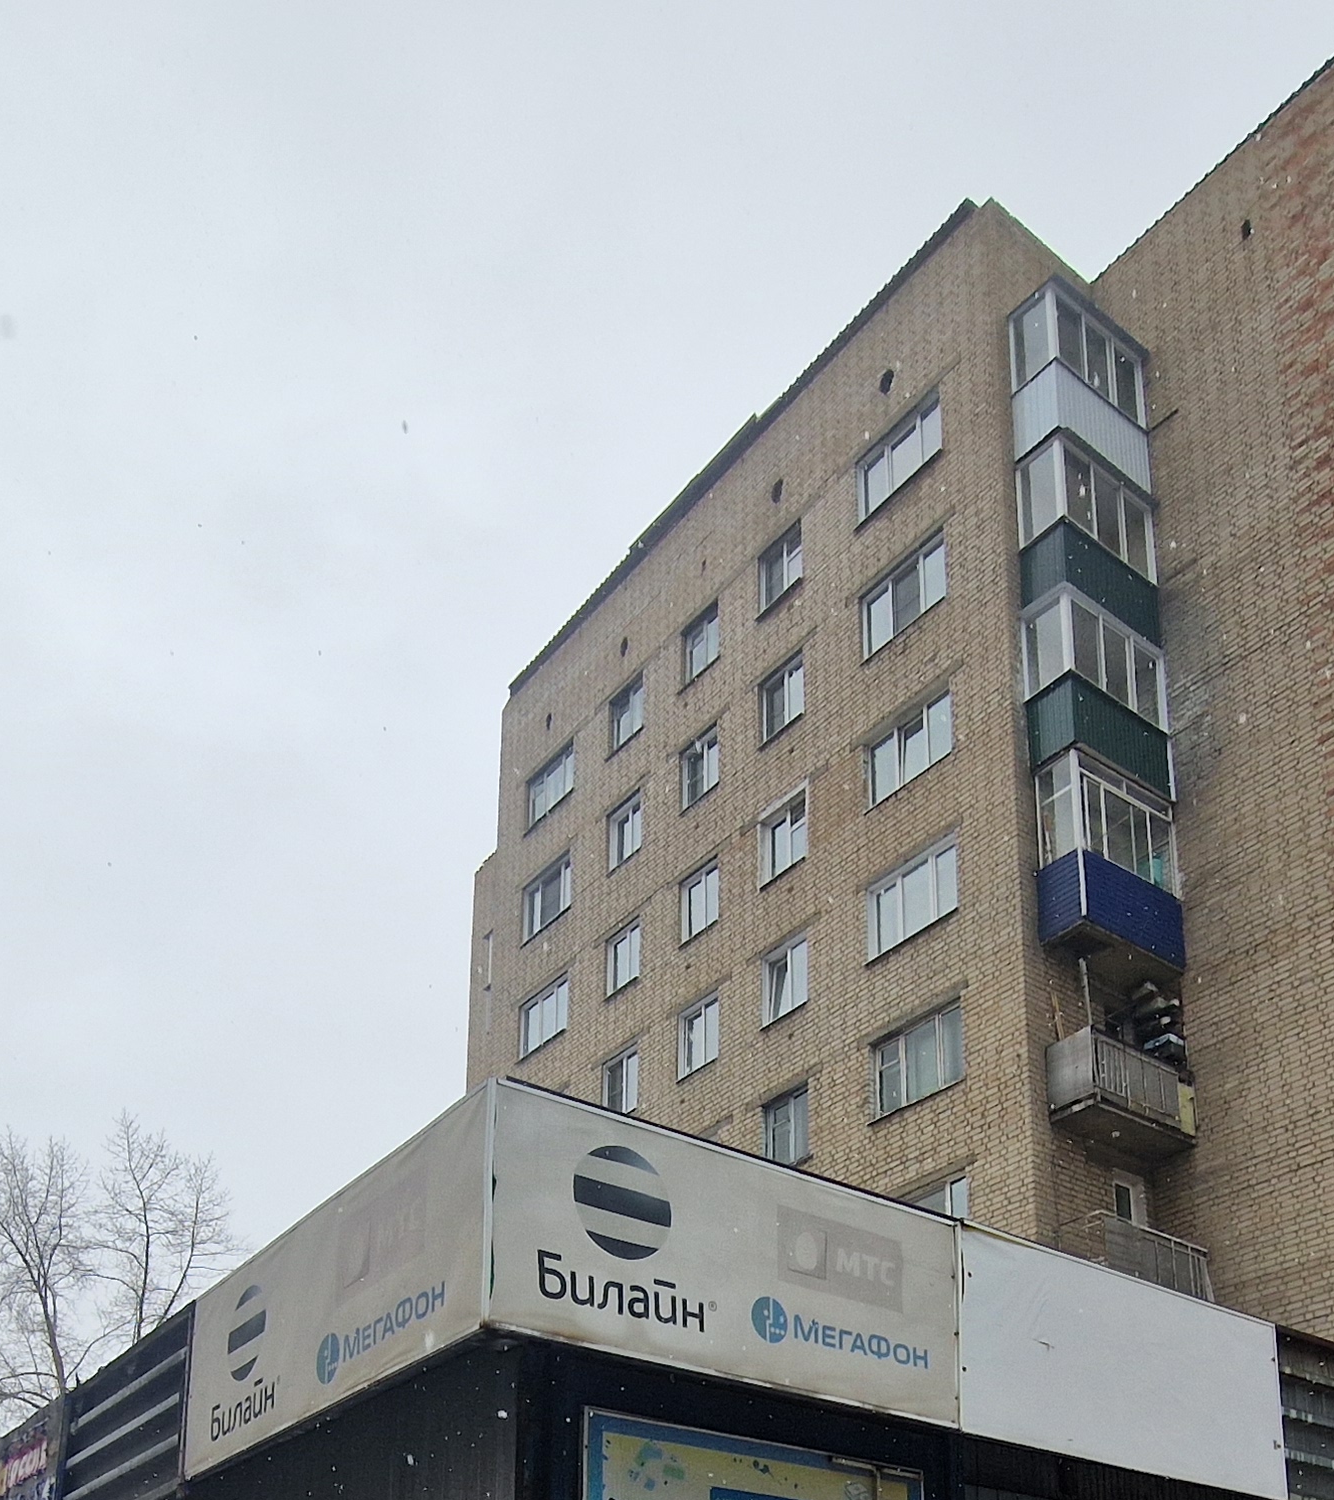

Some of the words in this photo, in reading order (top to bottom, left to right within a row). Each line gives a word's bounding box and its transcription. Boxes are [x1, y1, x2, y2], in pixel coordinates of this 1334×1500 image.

[538, 1250, 704, 1332] Билайн
[835, 1248, 896, 1287] МТС
[343, 1280, 446, 1363] МЕГАФОН
[793, 1314, 929, 1369] МЕГАФОН
[210, 1377, 276, 1442] Билайн
